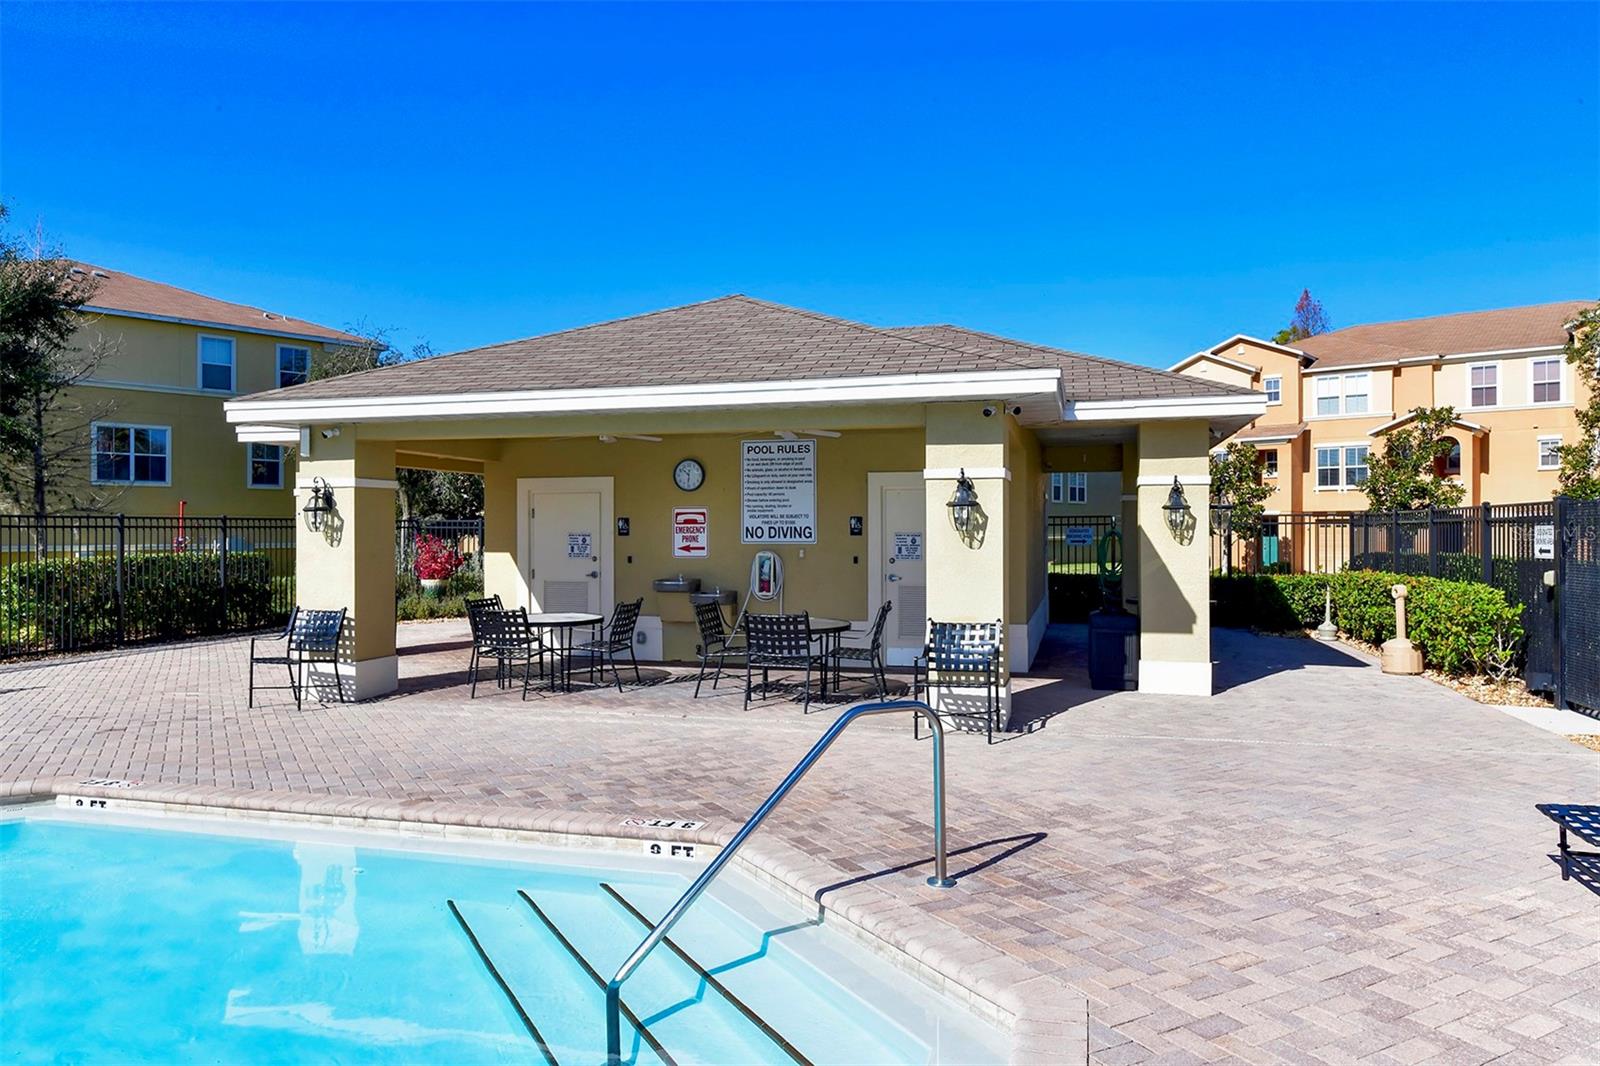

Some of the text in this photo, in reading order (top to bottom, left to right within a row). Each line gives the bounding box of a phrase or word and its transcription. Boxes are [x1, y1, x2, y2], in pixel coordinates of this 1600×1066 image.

[747, 444, 811, 454] POOL RULES
[676, 526, 705, 534] EMERGENCY
[745, 526, 813, 539] NO DIVING
[681, 535, 699, 543] PHONE
